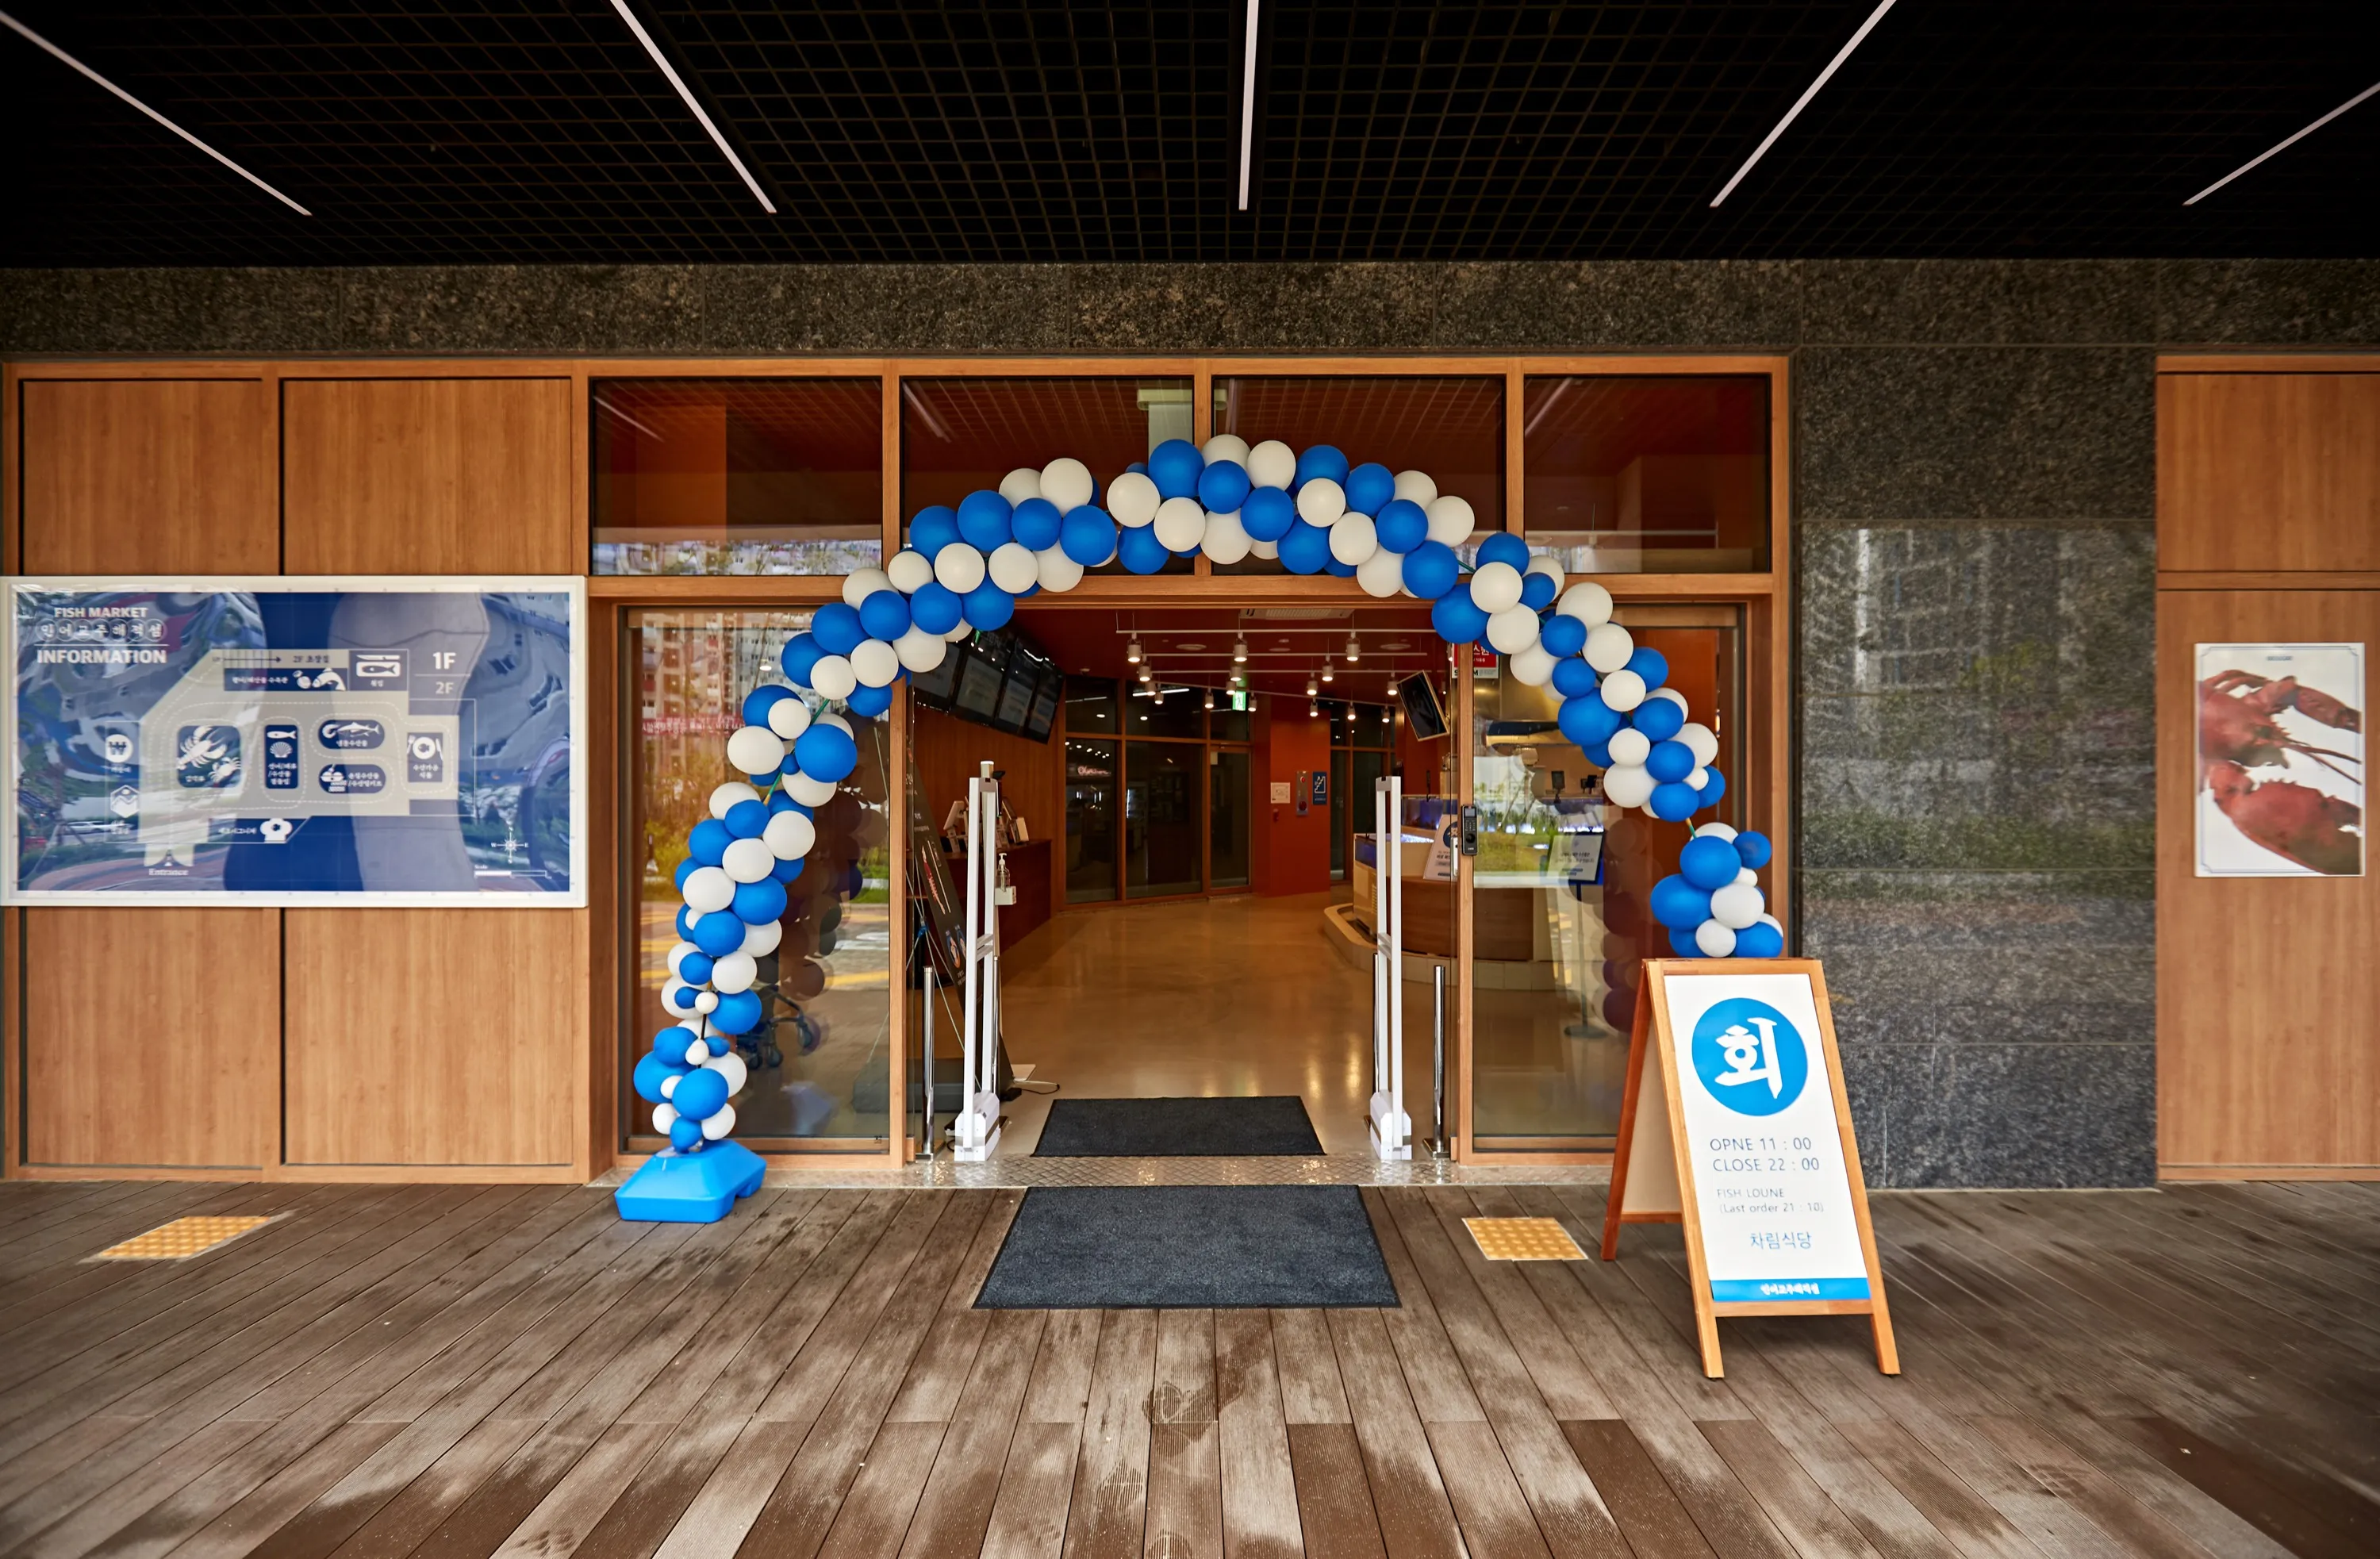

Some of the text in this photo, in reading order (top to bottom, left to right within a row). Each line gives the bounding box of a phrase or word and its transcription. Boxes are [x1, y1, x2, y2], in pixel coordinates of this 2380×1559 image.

[54, 607, 148, 618] FISH MARKET
[36, 650, 167, 664] INFORMATION
[432, 651, 457, 670] 1F
[436, 681, 455, 695] 2F
[1714, 1016, 1783, 1100] 회
[1710, 1138, 1753, 1151] OPNE
[1760, 1138, 1776, 1151] 11
[1793, 1137, 1812, 1150] 00
[1713, 1158, 1762, 1172] CLOSE
[1768, 1158, 1786, 1171] 22
[1801, 1158, 1820, 1170] 00
[1717, 1188, 1785, 1199] FISH LOUNE
[1720, 1204, 1745, 1214] (Last
[1749, 1203, 1779, 1212] order
[1783, 1203, 1795, 1212] 21
[1750, 1231, 1812, 1250] 차림식당
